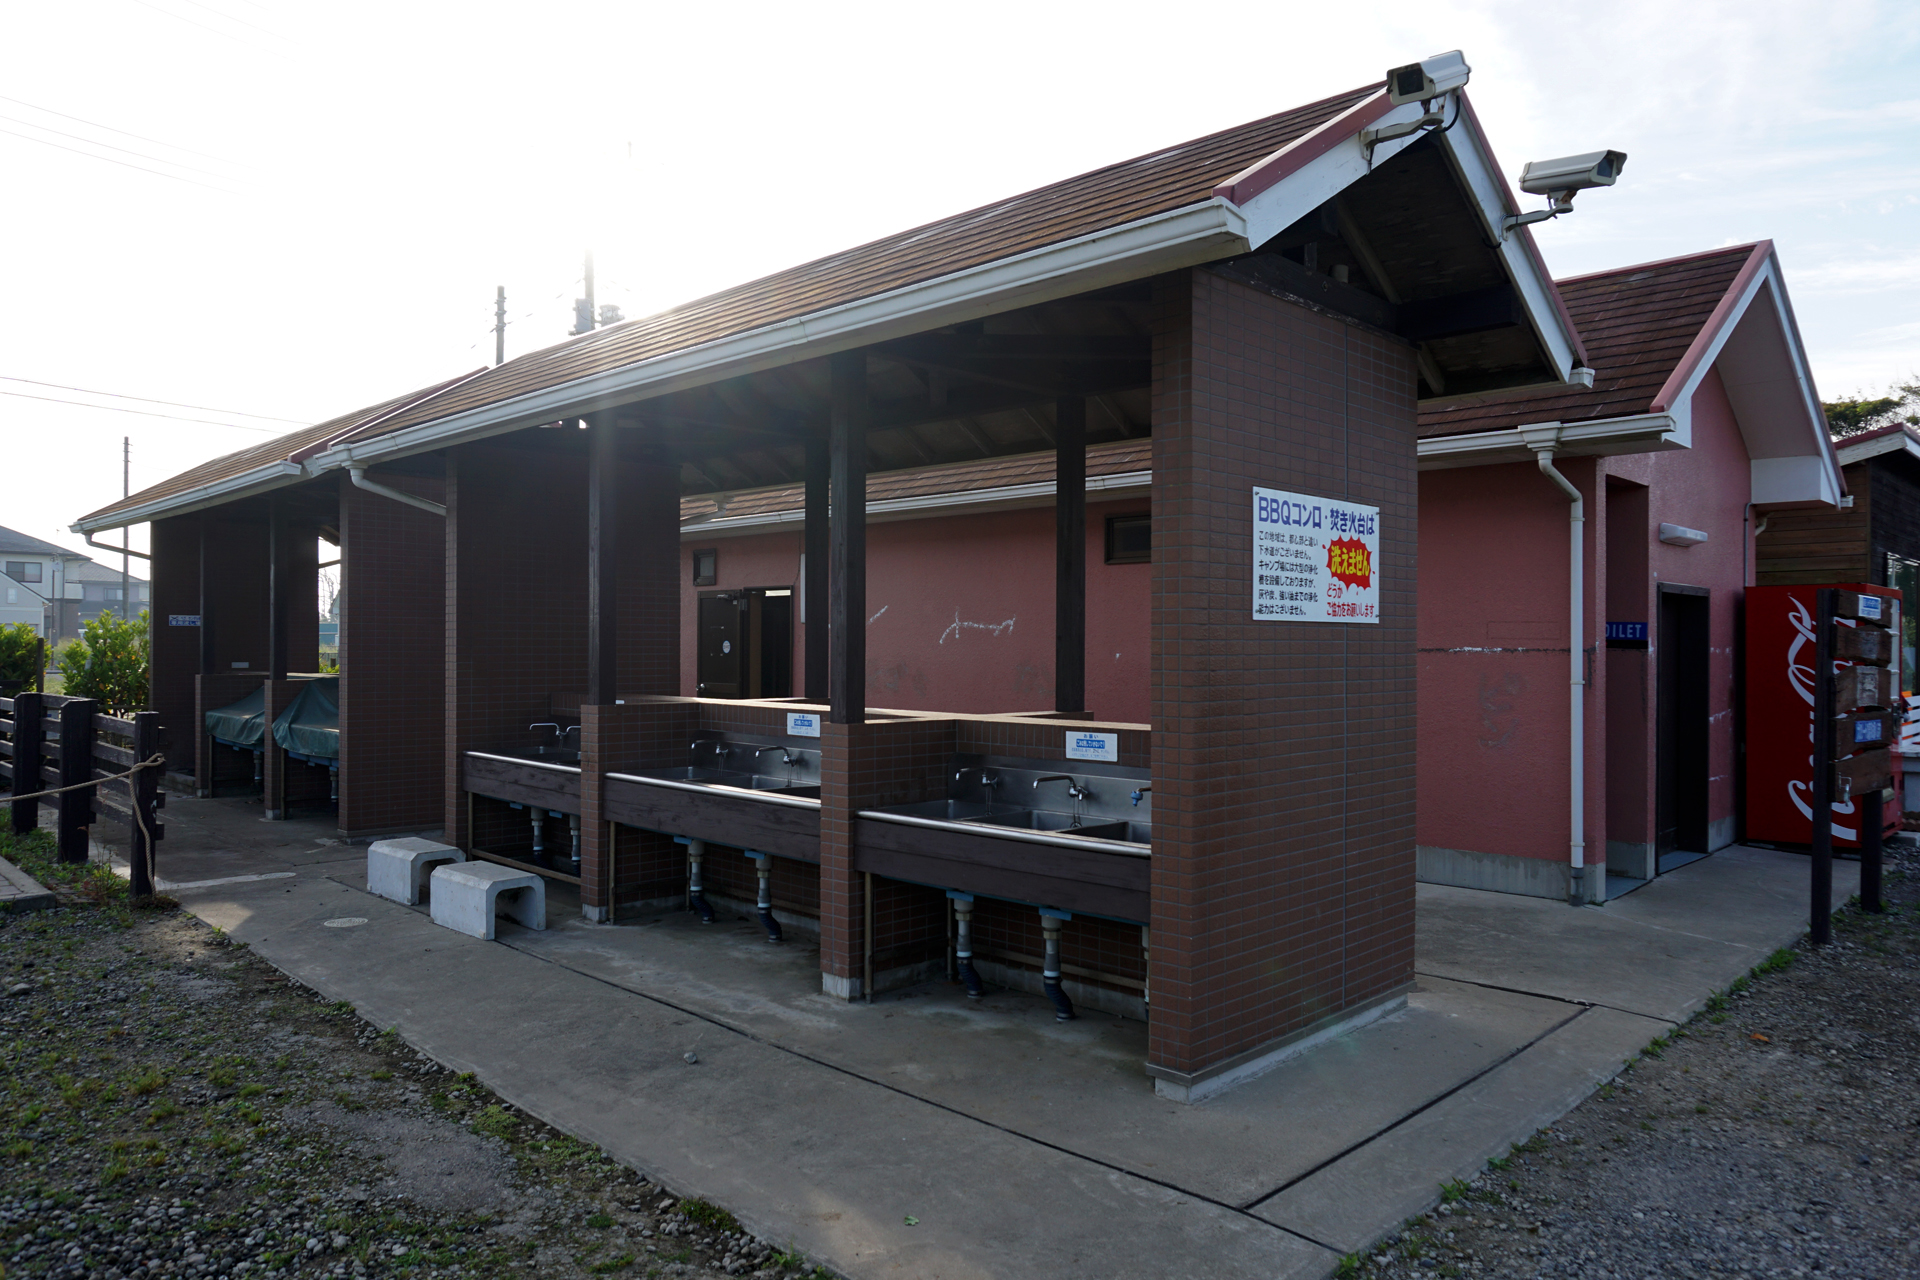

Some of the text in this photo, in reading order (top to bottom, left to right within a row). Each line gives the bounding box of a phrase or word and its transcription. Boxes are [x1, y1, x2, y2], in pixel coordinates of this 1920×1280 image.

[1331, 545, 1370, 576] 洗えません
[1326, 583, 1343, 599] どうか
[1326, 601, 1375, 618] ご協力をお願いします
[1606, 624, 1642, 638] OILET
